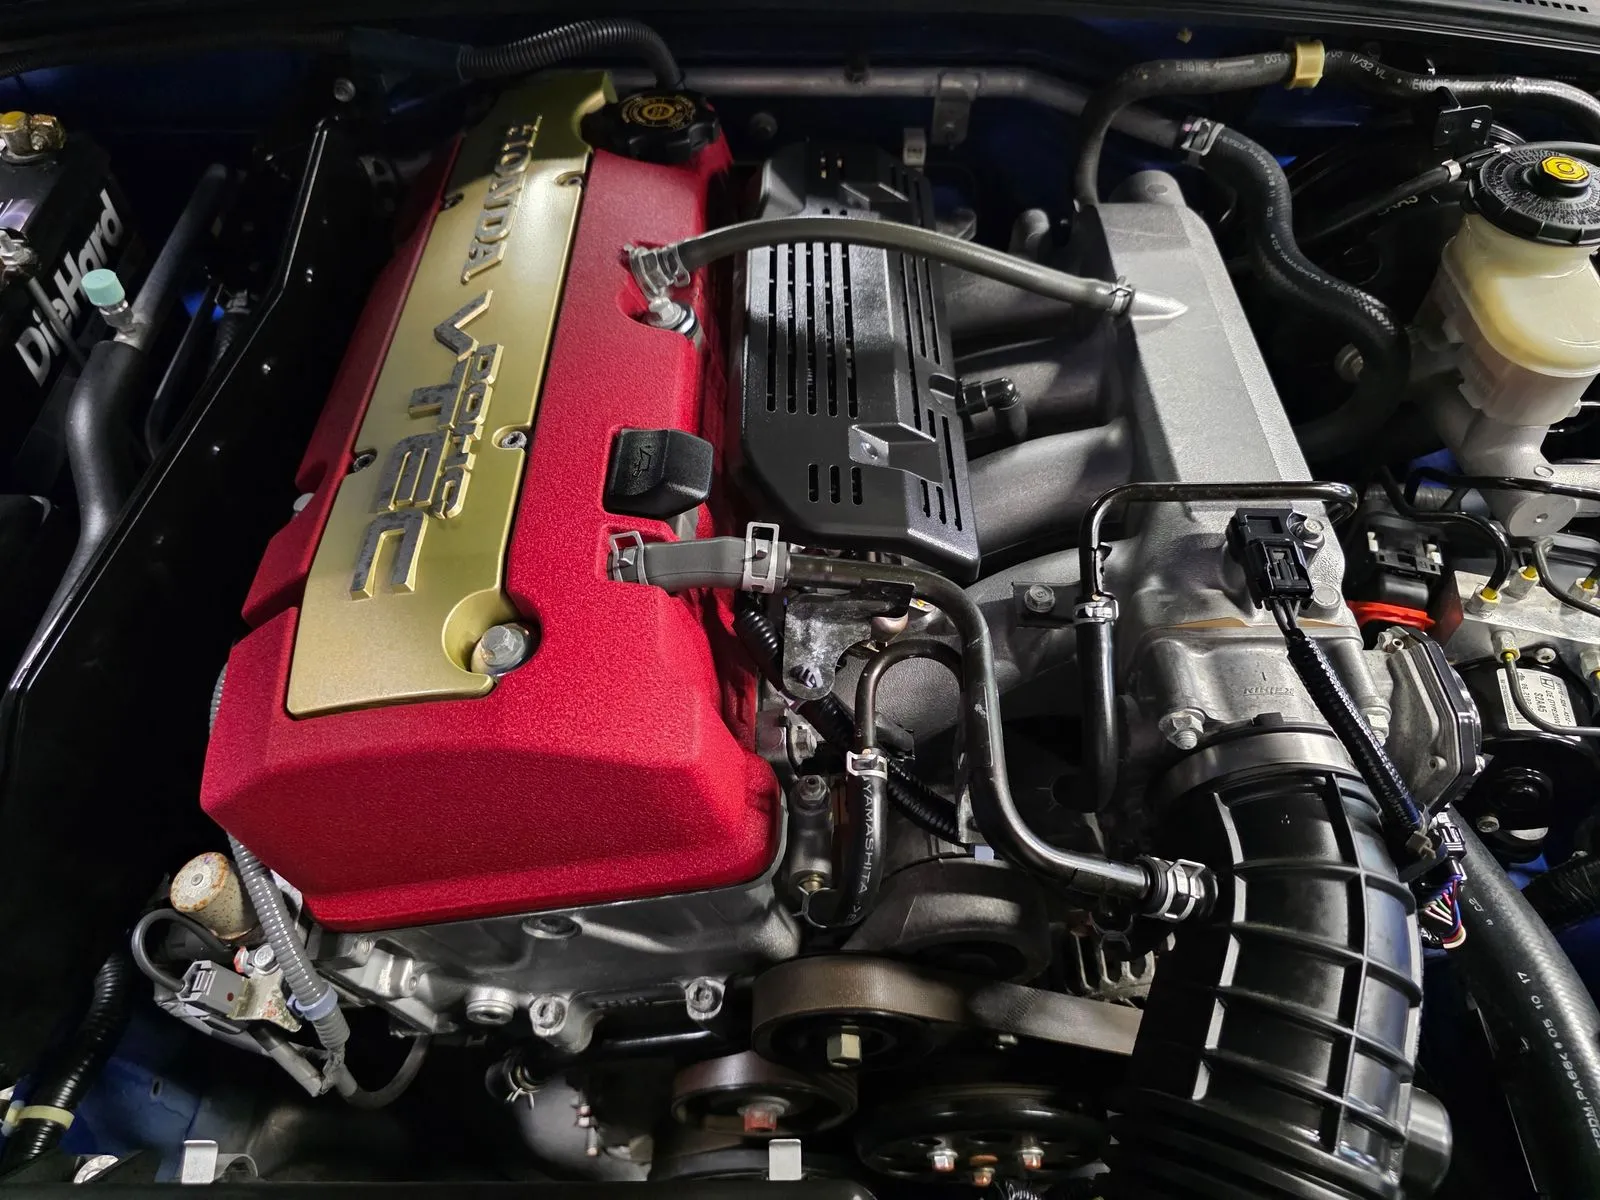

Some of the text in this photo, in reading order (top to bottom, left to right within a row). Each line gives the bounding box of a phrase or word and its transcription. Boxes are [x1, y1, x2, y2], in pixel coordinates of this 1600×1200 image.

[460, 113, 543, 285] HONDA
[14, 188, 124, 388] DieHard
[349, 289, 493, 601] VTEC
[431, 342, 504, 520] DOHC
[857, 784, 875, 893] YAMASHITA
[1516, 971, 1532, 985] 17
[1530, 995, 1545, 1010] 10
[1542, 1018, 1558, 1039] 05
